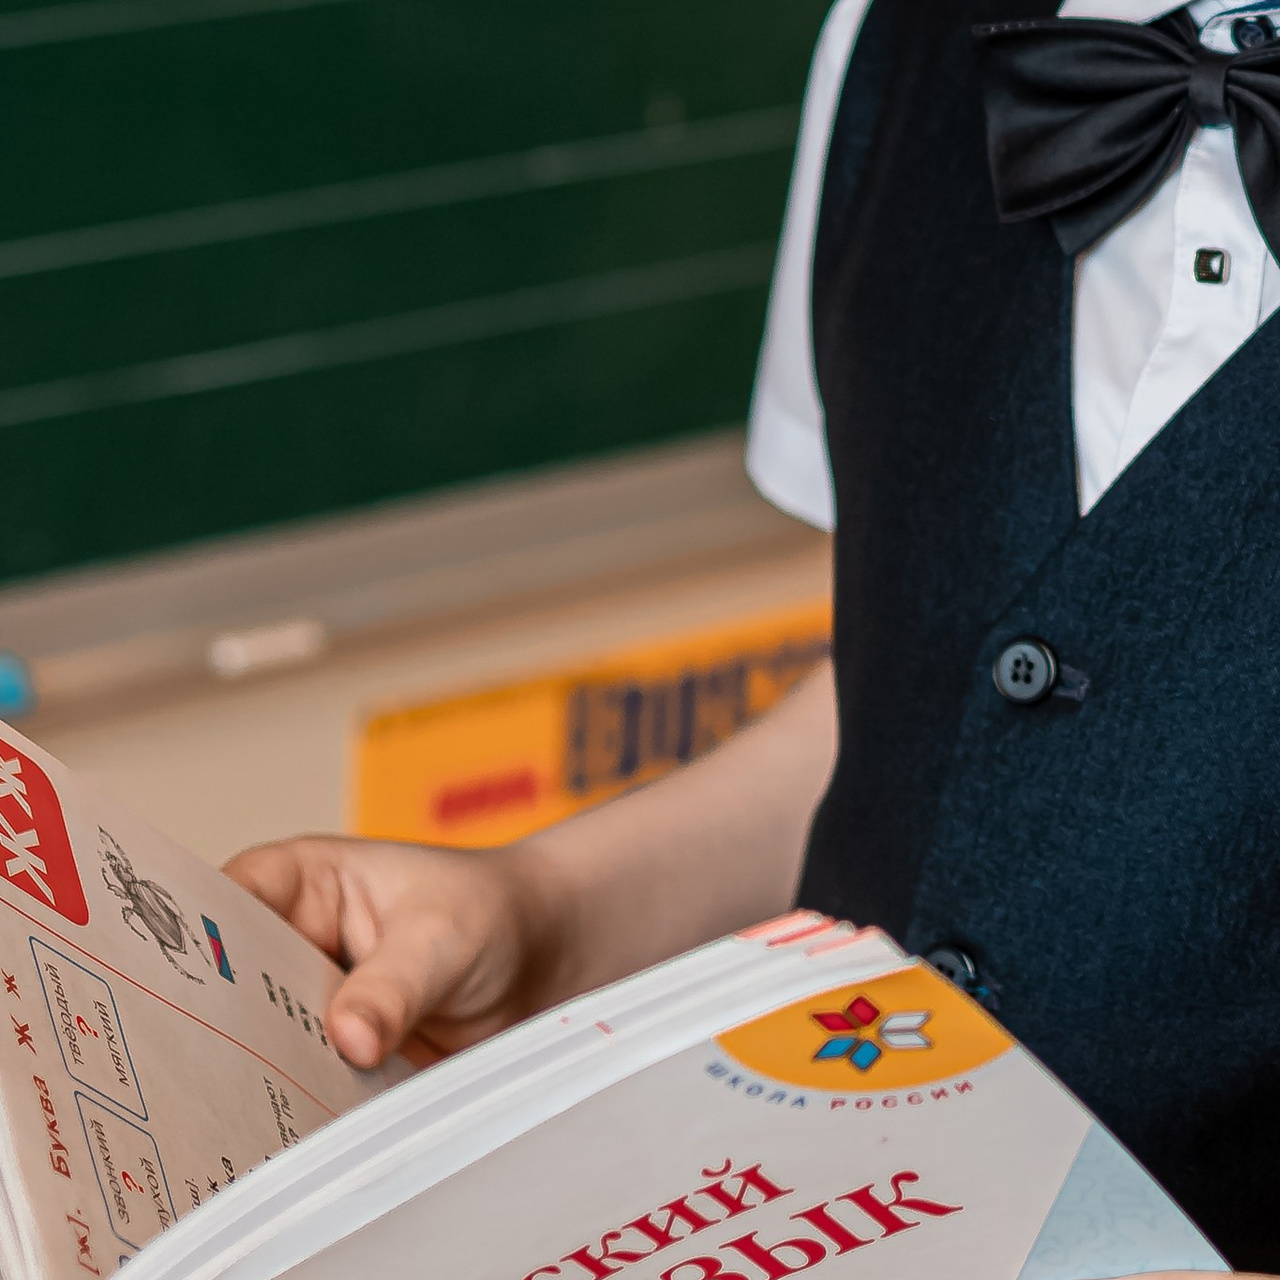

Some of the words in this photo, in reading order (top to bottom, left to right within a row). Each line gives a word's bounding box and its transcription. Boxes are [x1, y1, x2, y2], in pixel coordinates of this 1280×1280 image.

[44, 962, 85, 1065] твёрдый
[76, 1015, 99, 1039] ?
[93, 999, 130, 1087] мягкий
[33, 1074, 73, 1180] Буква
[704, 1061, 809, 1111] ШКОЛА
[829, 1079, 975, 1111] РОССИИ
[89, 1118, 130, 1224] звонкий
[121, 1171, 145, 1194] ?
